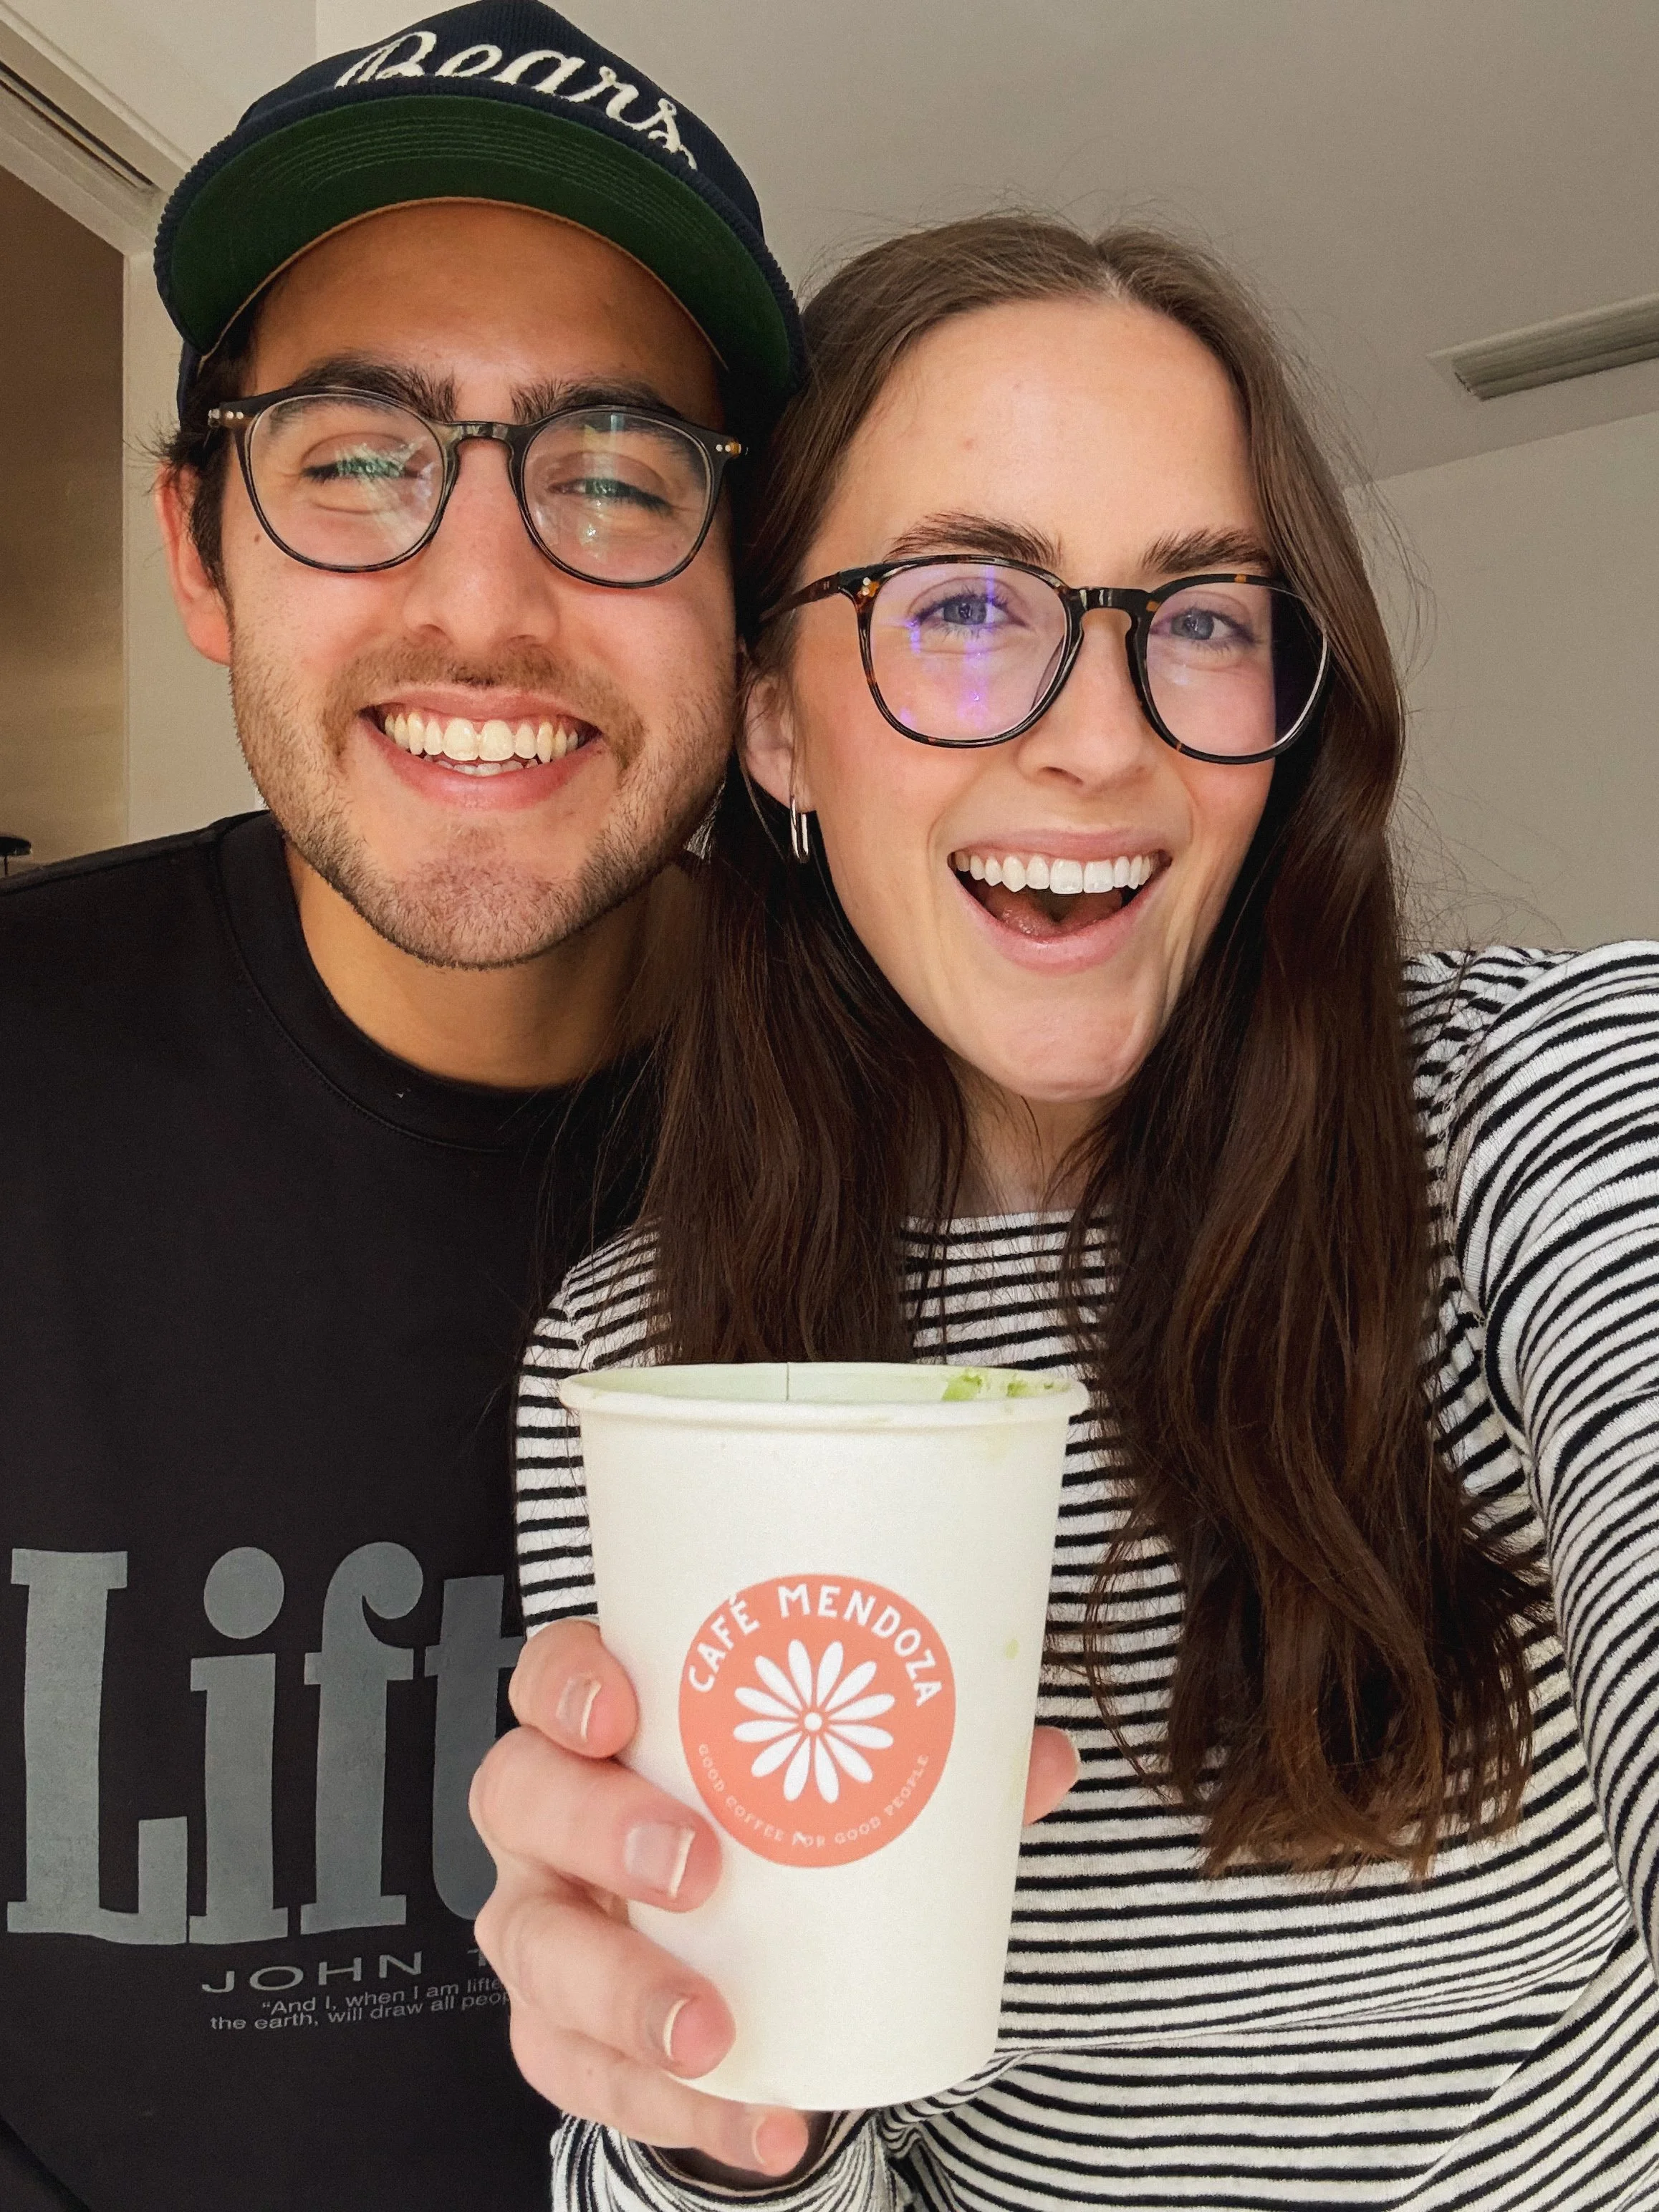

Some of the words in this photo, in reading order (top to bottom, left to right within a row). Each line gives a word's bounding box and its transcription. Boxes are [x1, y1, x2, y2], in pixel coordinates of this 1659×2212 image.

[334, 30, 698, 170] Bears
[688, 1593, 760, 1693] CAFÉ
[777, 1583, 943, 1707] MENDOZA
[6, 1541, 526, 1945] Lift
[698, 1743, 725, 1792] GOOD
[725, 1794, 784, 1842] COFFEE
[792, 1830, 825, 1848] FOR
[834, 1816, 882, 1845] GOOD
[883, 1754, 929, 1817] PEOPLE
[201, 1951, 423, 1994] JOHN
[210, 2016, 246, 2030] the
[254, 2011, 319, 2030] earth,
[327, 2007, 362, 2023] will
[370, 2003, 424, 2020] draw
[431, 1994, 455, 2011] all
[325, 1995, 337, 2011] I,
[345, 1991, 405, 2007] when
[413, 1985, 418, 1999] I
[426, 1983, 459, 1998] am
